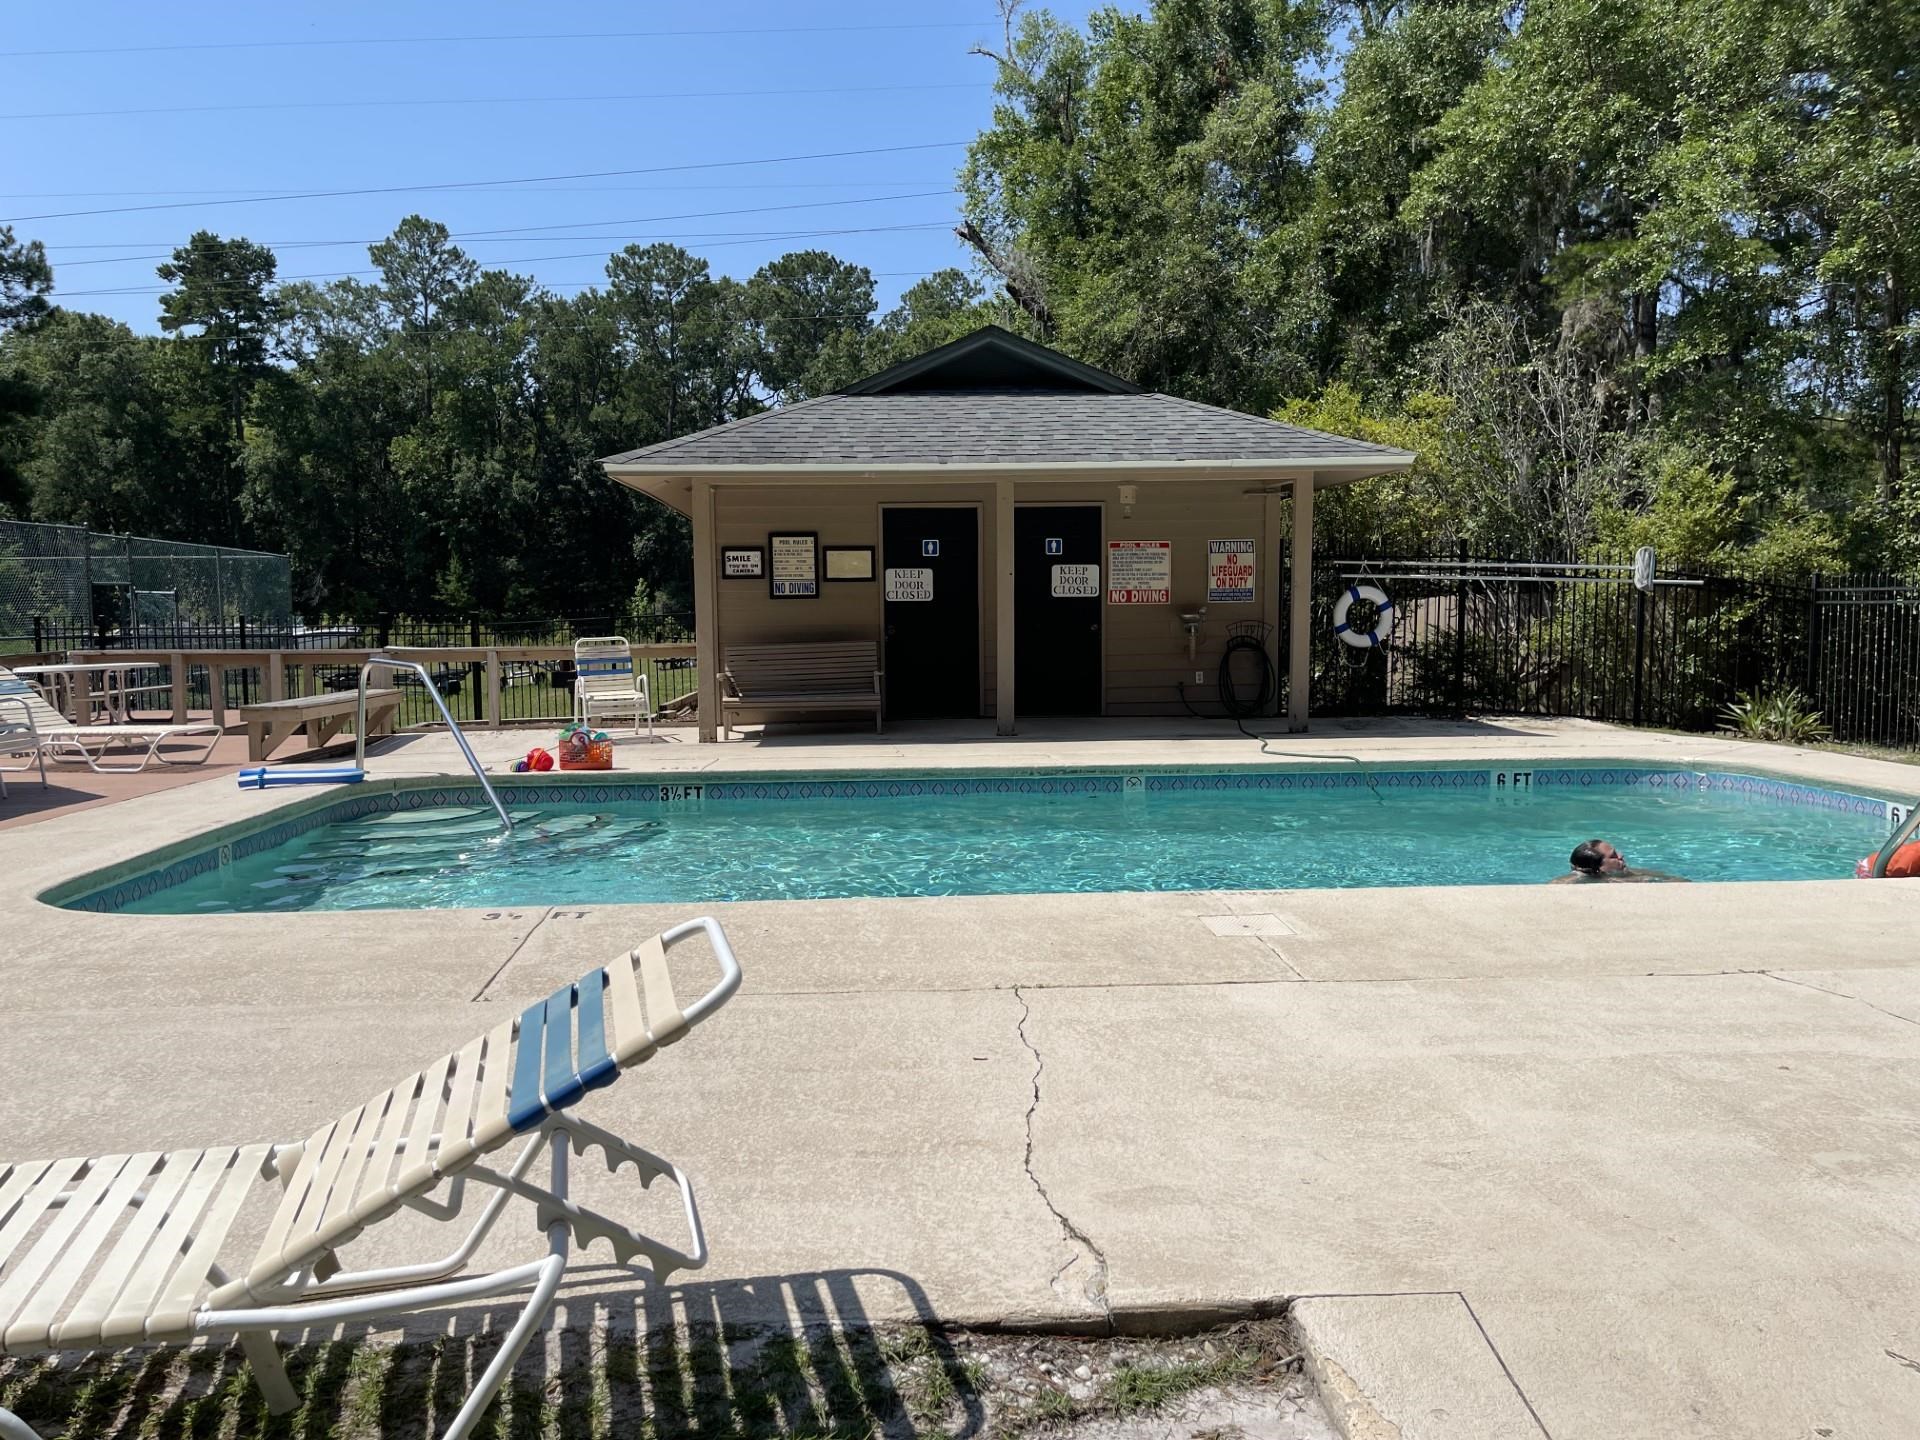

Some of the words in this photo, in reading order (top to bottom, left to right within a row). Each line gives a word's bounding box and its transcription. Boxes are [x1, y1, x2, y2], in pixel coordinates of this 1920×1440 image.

[1210, 541, 1253, 553] WARNING
[1226, 553, 1238, 565] NO
[894, 569, 924, 579] KEEP
[1059, 566, 1088, 575] KEEP
[1211, 565, 1253, 577] LIFEGUARD
[894, 580, 925, 590] DOOR
[1059, 575, 1089, 585] DOOR
[1216, 577, 1227, 588] ON
[1228, 576, 1248, 588] DUTY
[774, 582, 786, 594] NO
[788, 582, 815, 594] DIVING
[1053, 585, 1098, 595] CLOSED
[886, 590, 931, 600] CLOSED
[1111, 590, 1127, 603] NO
[1131, 590, 1167, 602] DIVING
[1513, 772, 1532, 786] FT
[684, 786, 703, 800] FT
[1891, 806, 1900, 823] 6
[549, 911, 592, 920] FT
